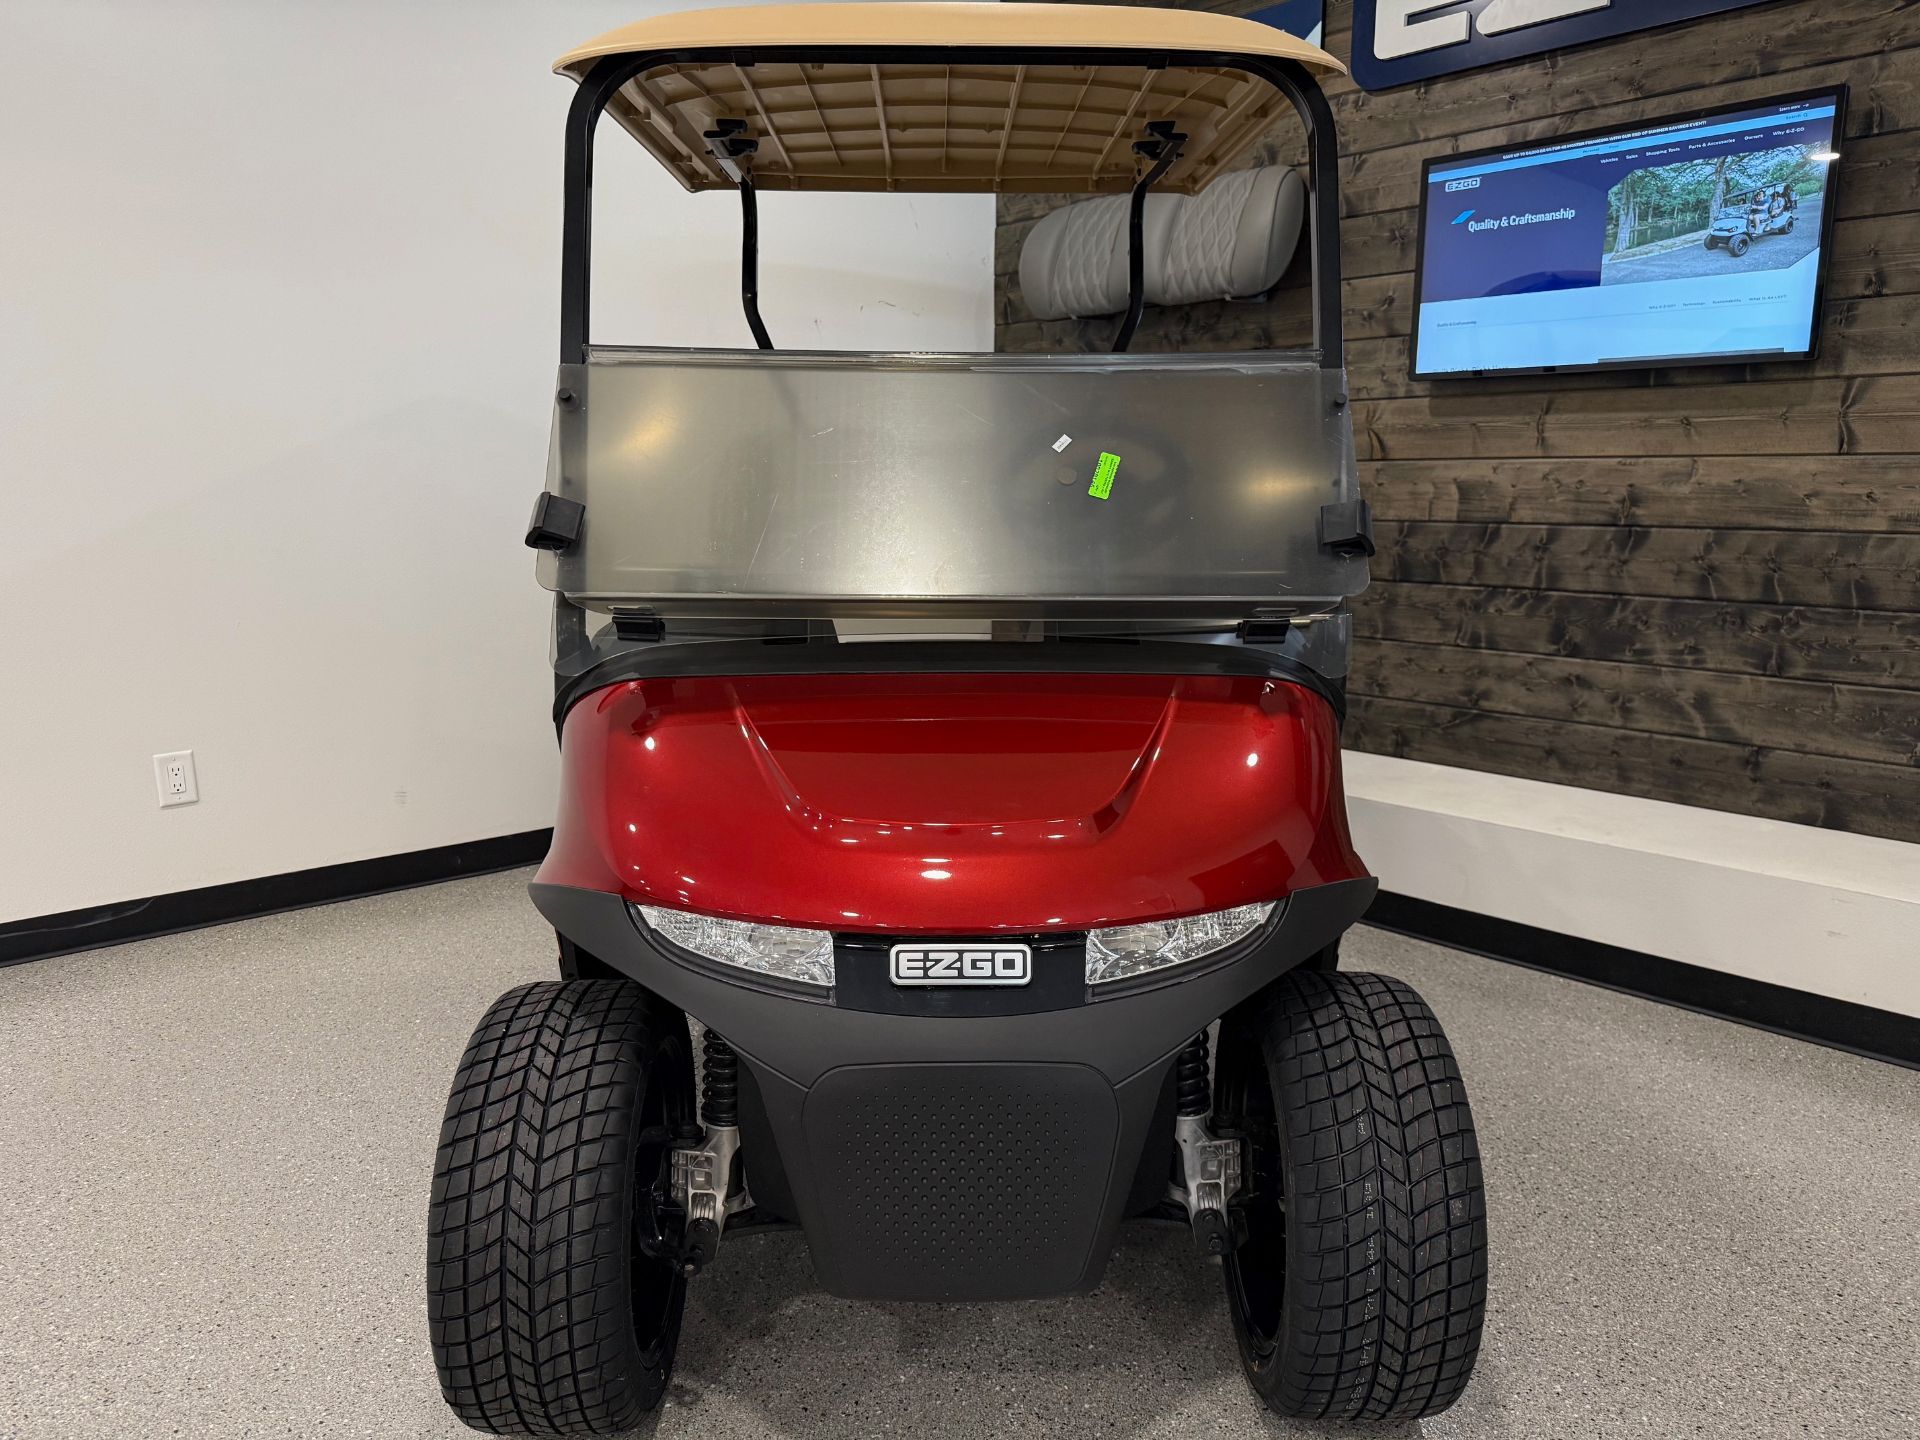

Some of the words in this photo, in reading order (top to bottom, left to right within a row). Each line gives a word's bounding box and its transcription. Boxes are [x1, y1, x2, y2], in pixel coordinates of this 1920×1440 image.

[1468, 218, 1500, 232] Quality
[1500, 216, 1509, 227] &
[1510, 208, 1576, 226] Craftsmanship
